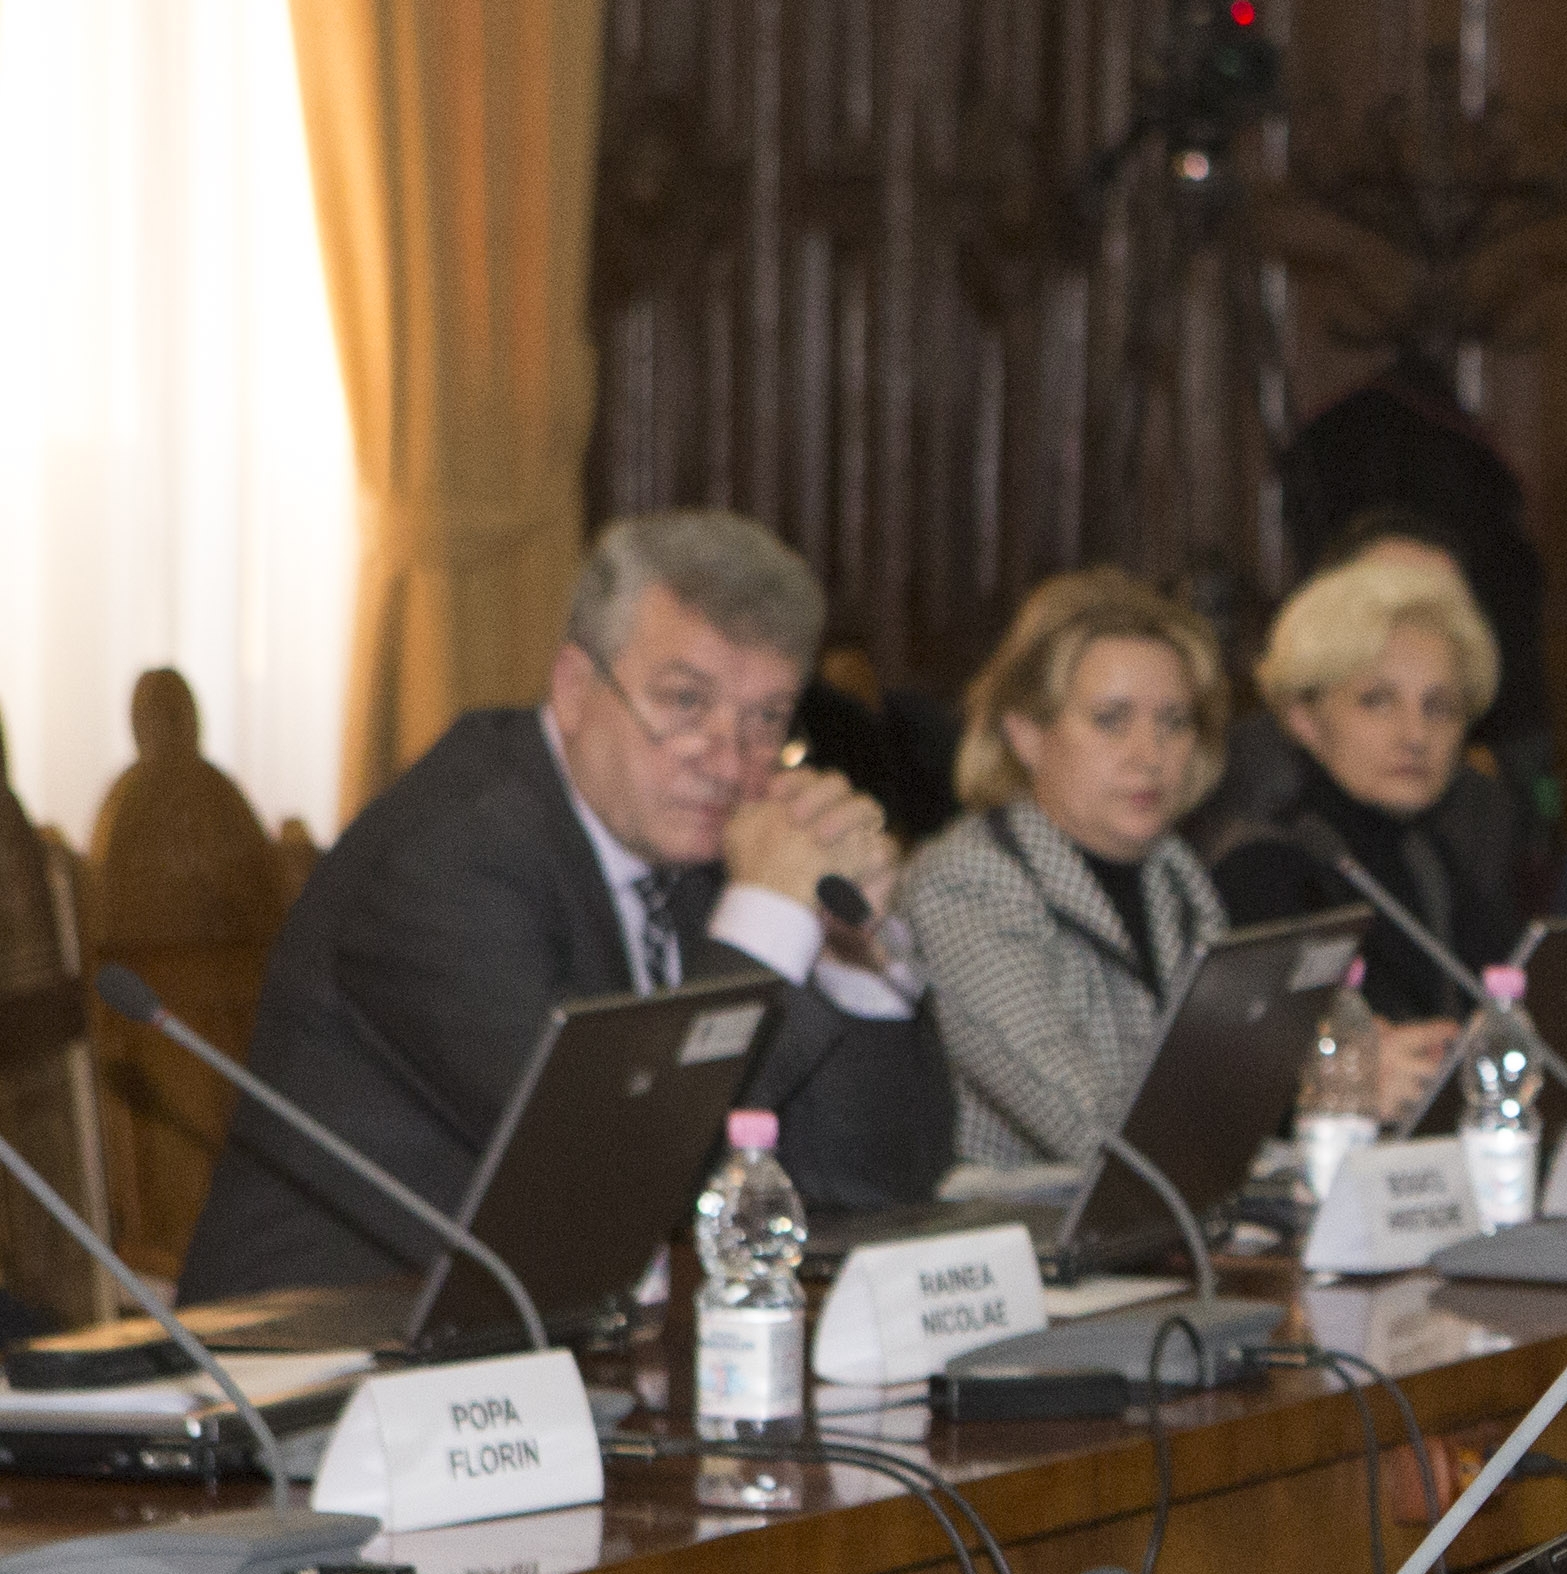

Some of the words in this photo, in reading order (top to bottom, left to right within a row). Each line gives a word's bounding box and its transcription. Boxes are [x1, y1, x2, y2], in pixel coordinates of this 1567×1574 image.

[921, 1298, 1008, 1334] NICOLAE
[451, 1398, 522, 1433] POPA
[448, 1440, 541, 1479] FLORIN
